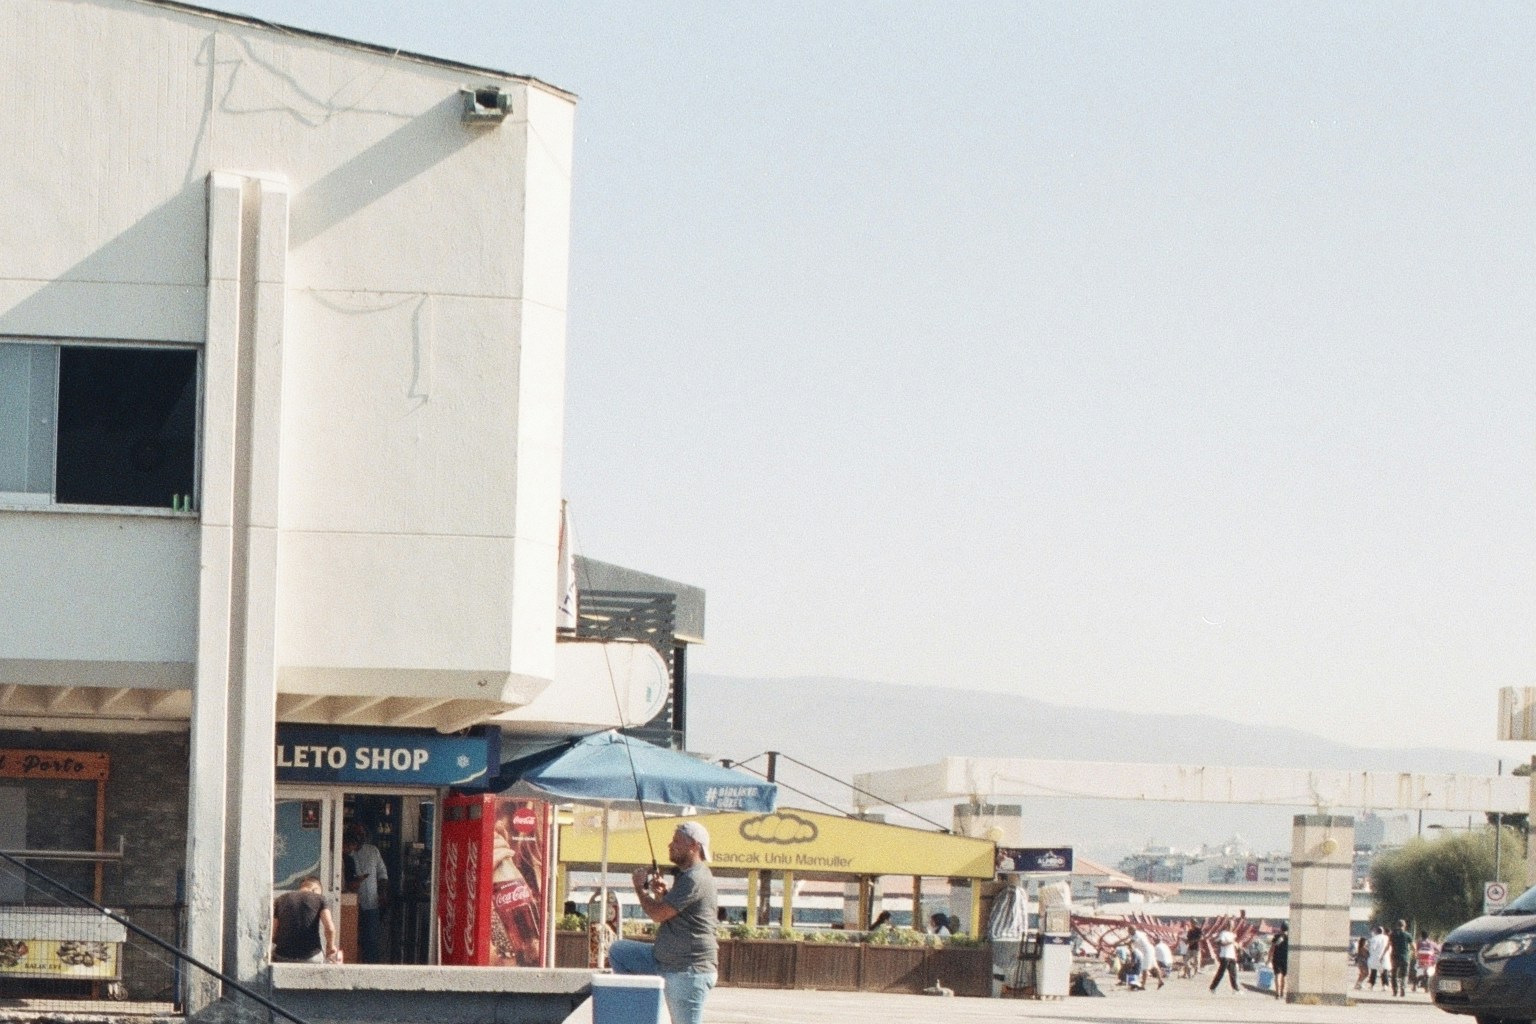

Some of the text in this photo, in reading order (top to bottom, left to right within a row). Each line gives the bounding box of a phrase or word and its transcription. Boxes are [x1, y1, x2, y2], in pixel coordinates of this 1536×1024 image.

[21, 755, 86, 773] Porto
[276, 745, 429, 771] LETO SHOP
